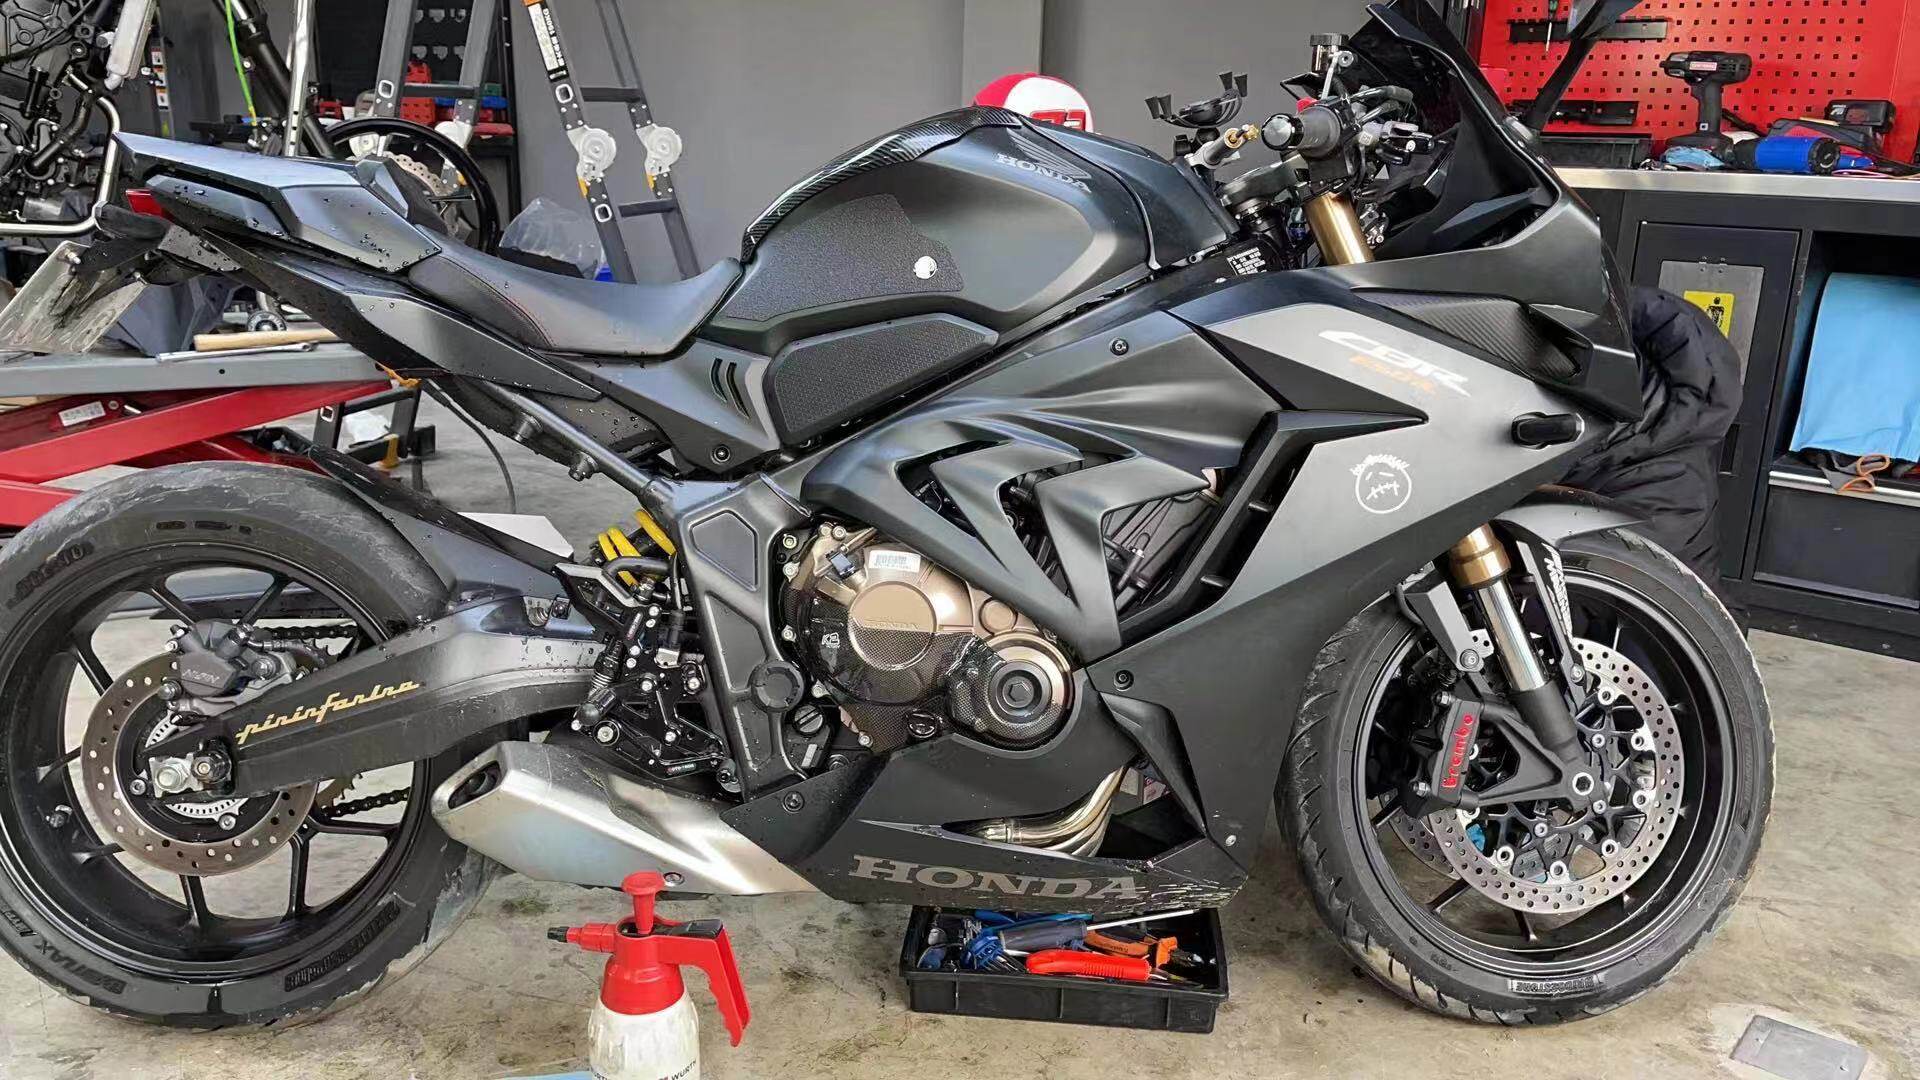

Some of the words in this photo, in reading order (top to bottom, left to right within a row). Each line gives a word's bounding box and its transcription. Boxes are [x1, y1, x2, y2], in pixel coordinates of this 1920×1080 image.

[997, 153, 1092, 193] HONDA
[1318, 330, 1471, 397] CBR
[235, 680, 420, 745] pininfarina
[1442, 714, 1473, 787] brembo
[848, 854, 1145, 900] HONDA
